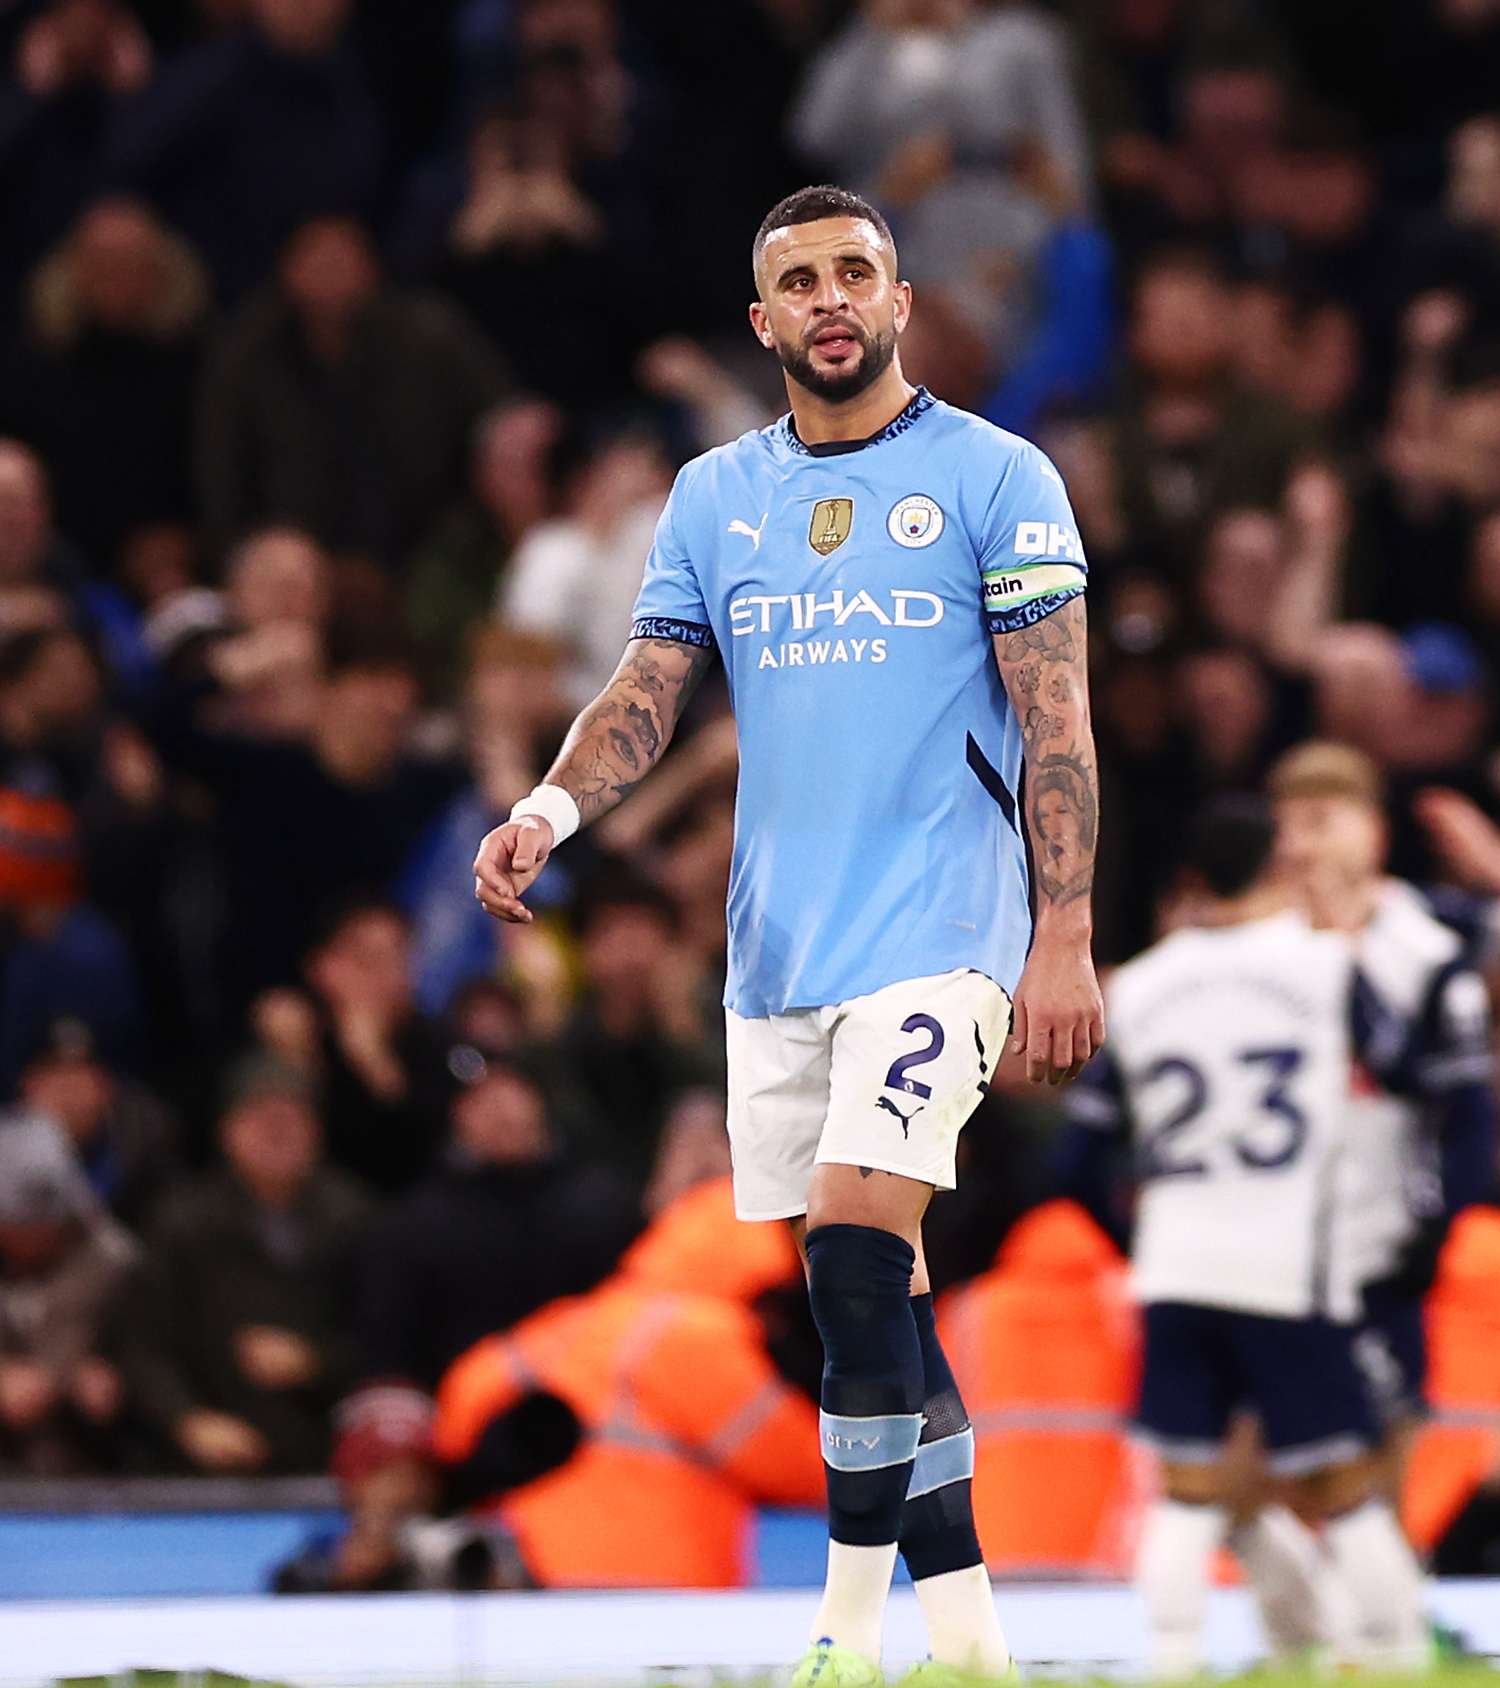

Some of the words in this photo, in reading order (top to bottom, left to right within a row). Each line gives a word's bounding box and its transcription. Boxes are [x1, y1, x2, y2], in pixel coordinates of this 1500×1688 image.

[819, 534, 840, 543] FIFA
[729, 589, 945, 636] ETIHAD
[758, 639, 888, 669] AIRWAYS
[885, 1012, 945, 1100] 2
[1140, 1046, 1307, 1178] 23
